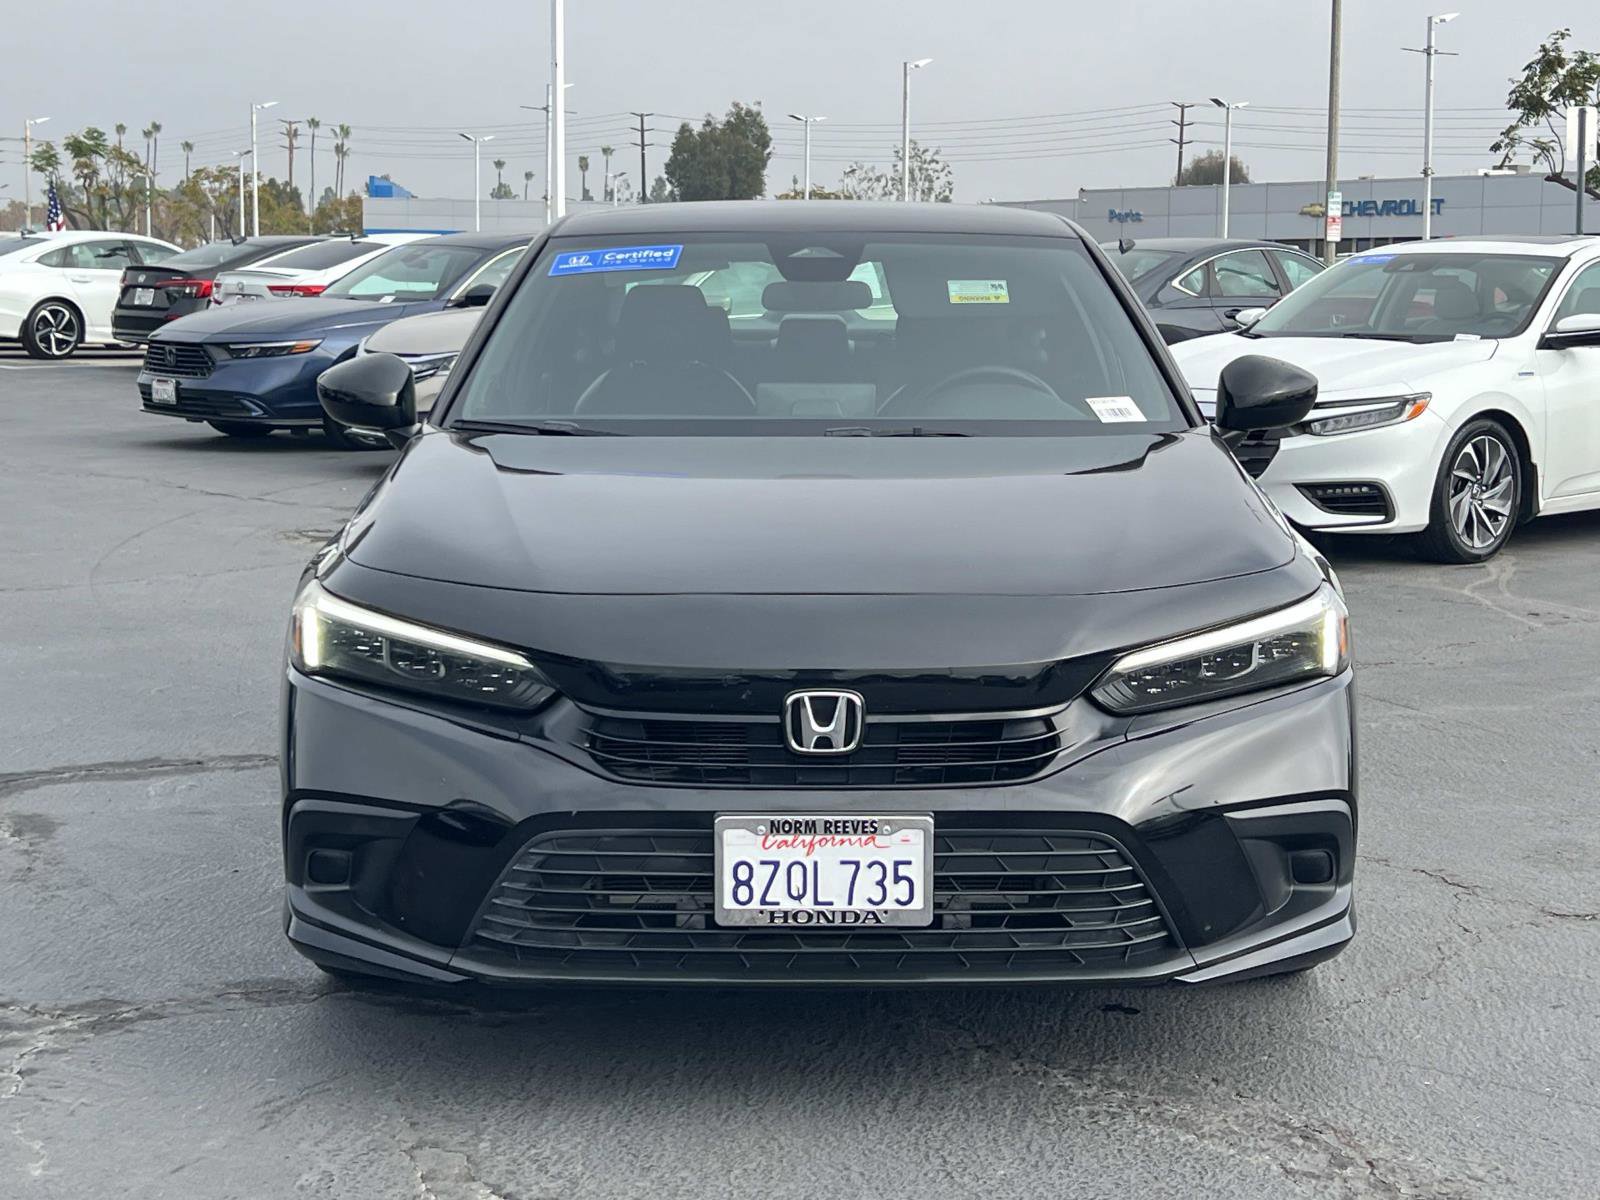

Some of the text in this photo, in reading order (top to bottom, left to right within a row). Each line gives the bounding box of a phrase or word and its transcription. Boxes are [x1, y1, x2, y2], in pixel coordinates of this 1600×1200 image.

[604, 249, 674, 260] Certified
[769, 819, 879, 835] NORM REEVES
[761, 834, 892, 857] California
[732, 860, 916, 906] 8ZQL735
[768, 910, 883, 924] HONDA
